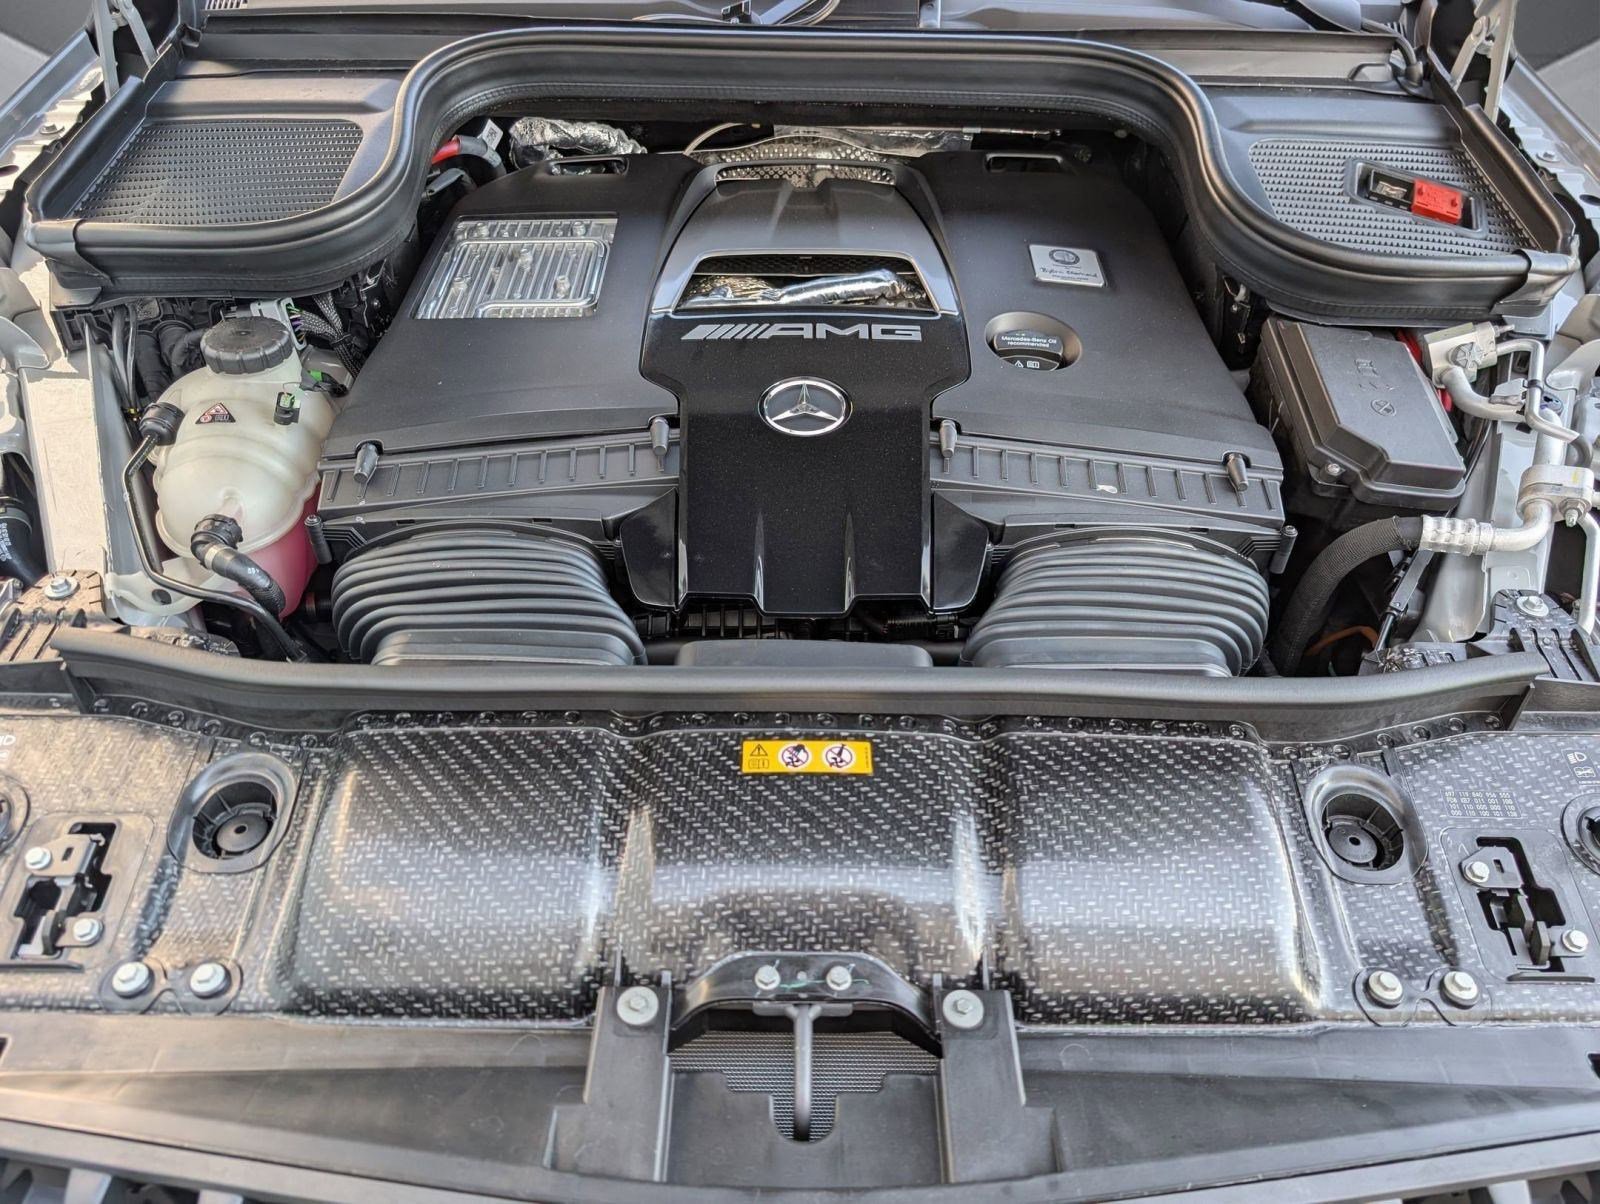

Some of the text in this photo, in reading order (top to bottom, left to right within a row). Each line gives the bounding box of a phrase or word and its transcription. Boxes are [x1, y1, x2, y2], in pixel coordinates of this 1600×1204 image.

[757, 323, 922, 342] AMG
[1001, 335, 1047, 343] Mercedes-Benz
[1007, 340, 1050, 348] recommended
